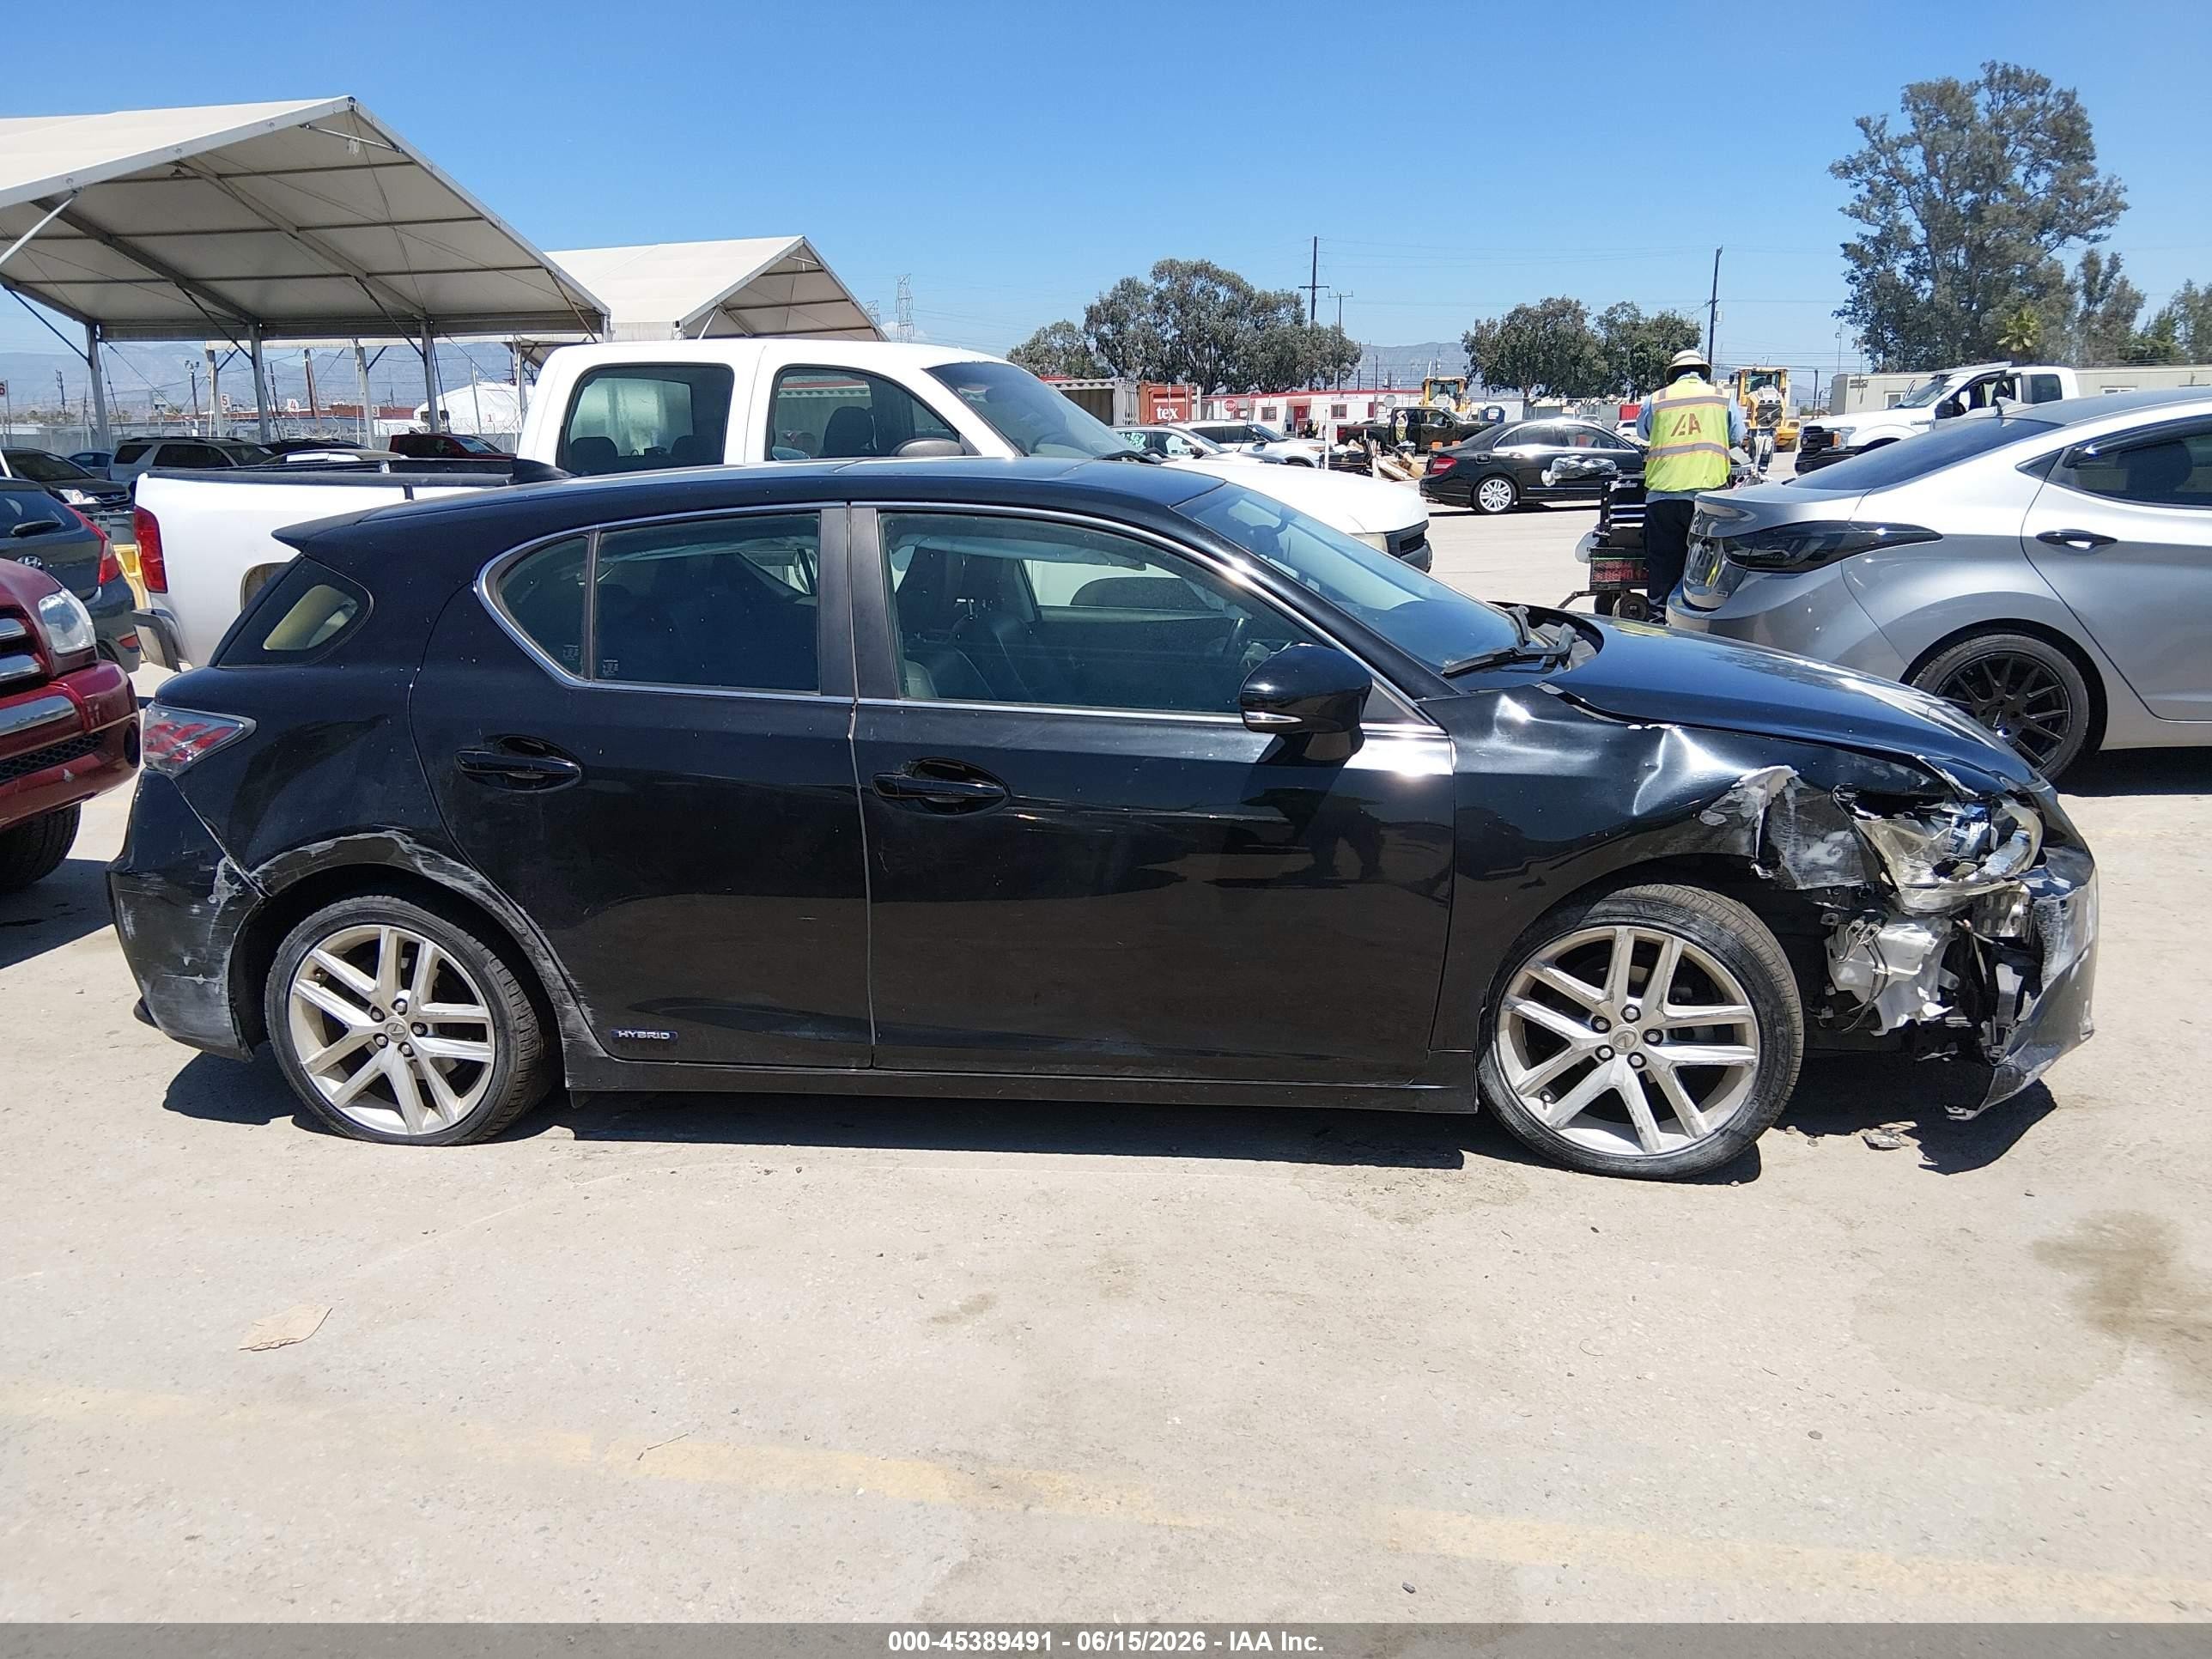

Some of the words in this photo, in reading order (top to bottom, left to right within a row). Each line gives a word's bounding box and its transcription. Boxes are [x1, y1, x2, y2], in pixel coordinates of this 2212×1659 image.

[222, 395, 228, 405] 5
[289, 399, 296, 410] 4
[1156, 404, 1180, 420] tex
[618, 1030, 671, 1040] HYBRID
